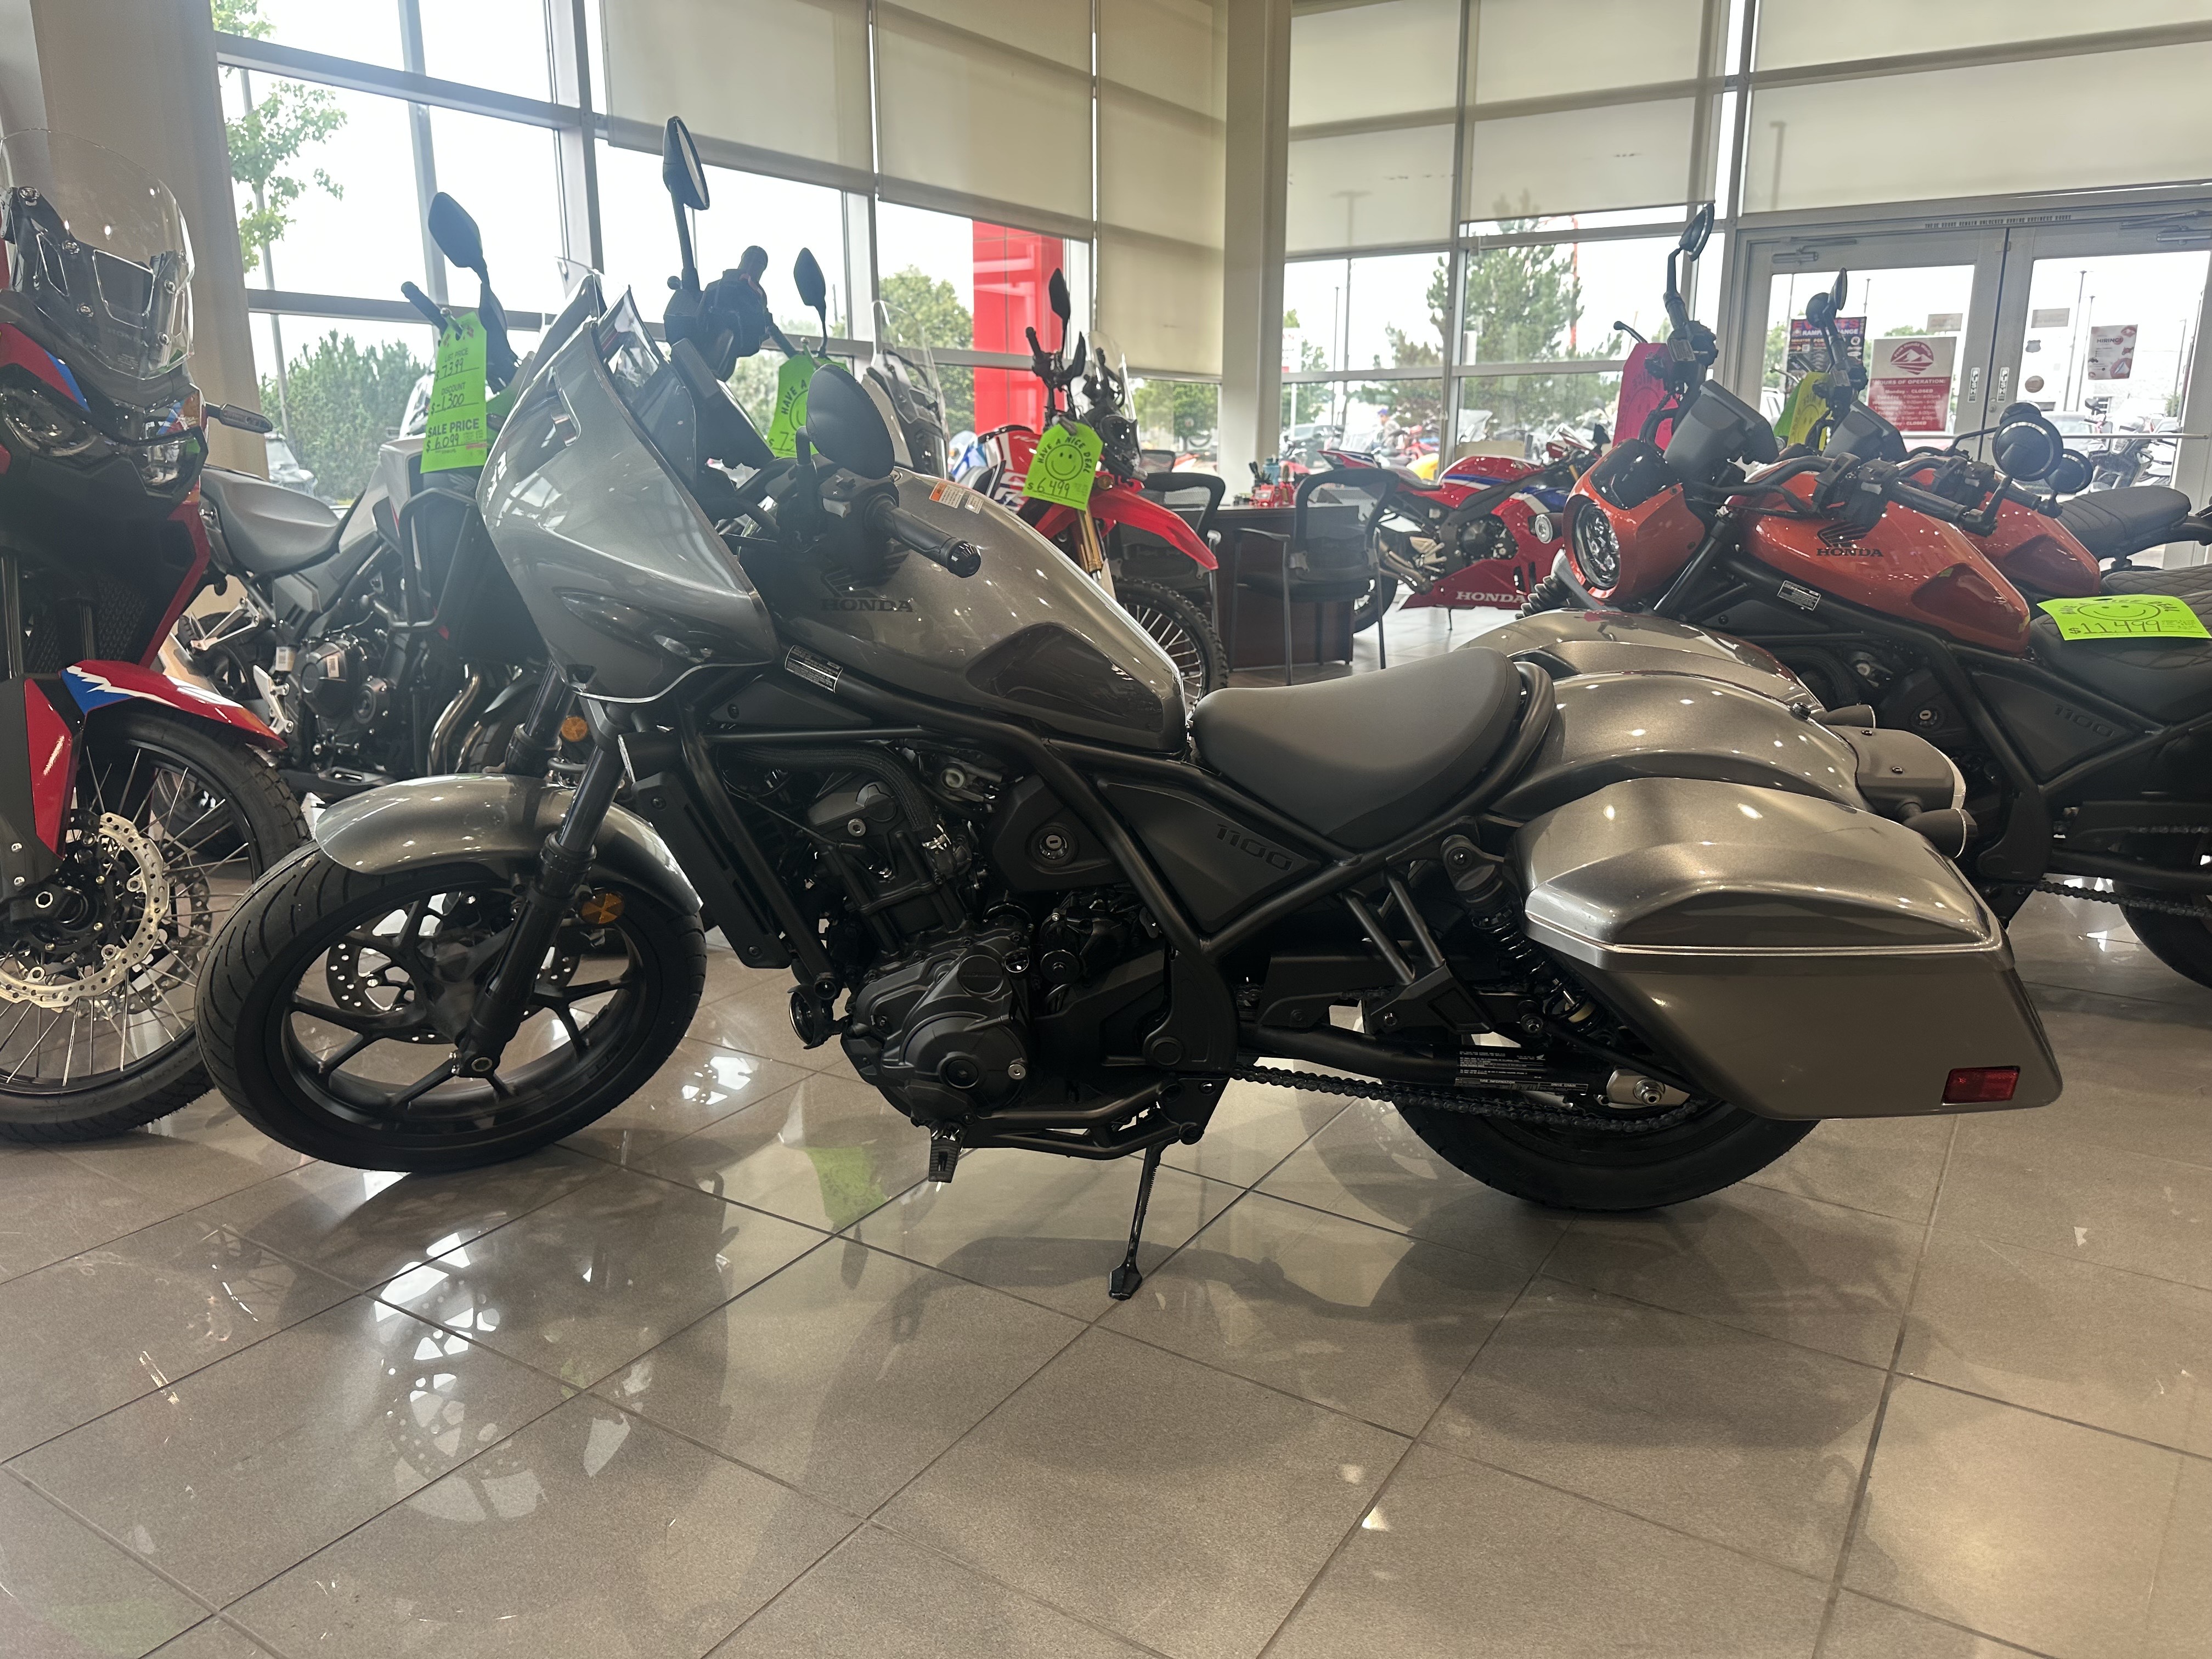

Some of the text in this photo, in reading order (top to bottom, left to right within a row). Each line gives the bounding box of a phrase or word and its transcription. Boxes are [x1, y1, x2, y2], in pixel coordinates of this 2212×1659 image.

[455, 348, 468, 358] PRICE
[441, 382, 466, 396] DISCOUNT
[1970, 370, 1978, 394] PUSH
[1999, 370, 2008, 394] PUSH
[781, 379, 807, 415] HAVE A
[427, 423, 448, 438] SALE
[449, 419, 479, 433] PRICE
[1037, 443, 1053, 464] HAVE
[1065, 436, 1086, 449] NICE
[1083, 452, 1092, 473] DEAL
[1816, 548, 1884, 557] HONDA
[821, 599, 913, 612] HONDA
[1455, 591, 1527, 603] HONDA
[2054, 704, 2114, 737] 1100
[1217, 823, 1294, 871] 1100
